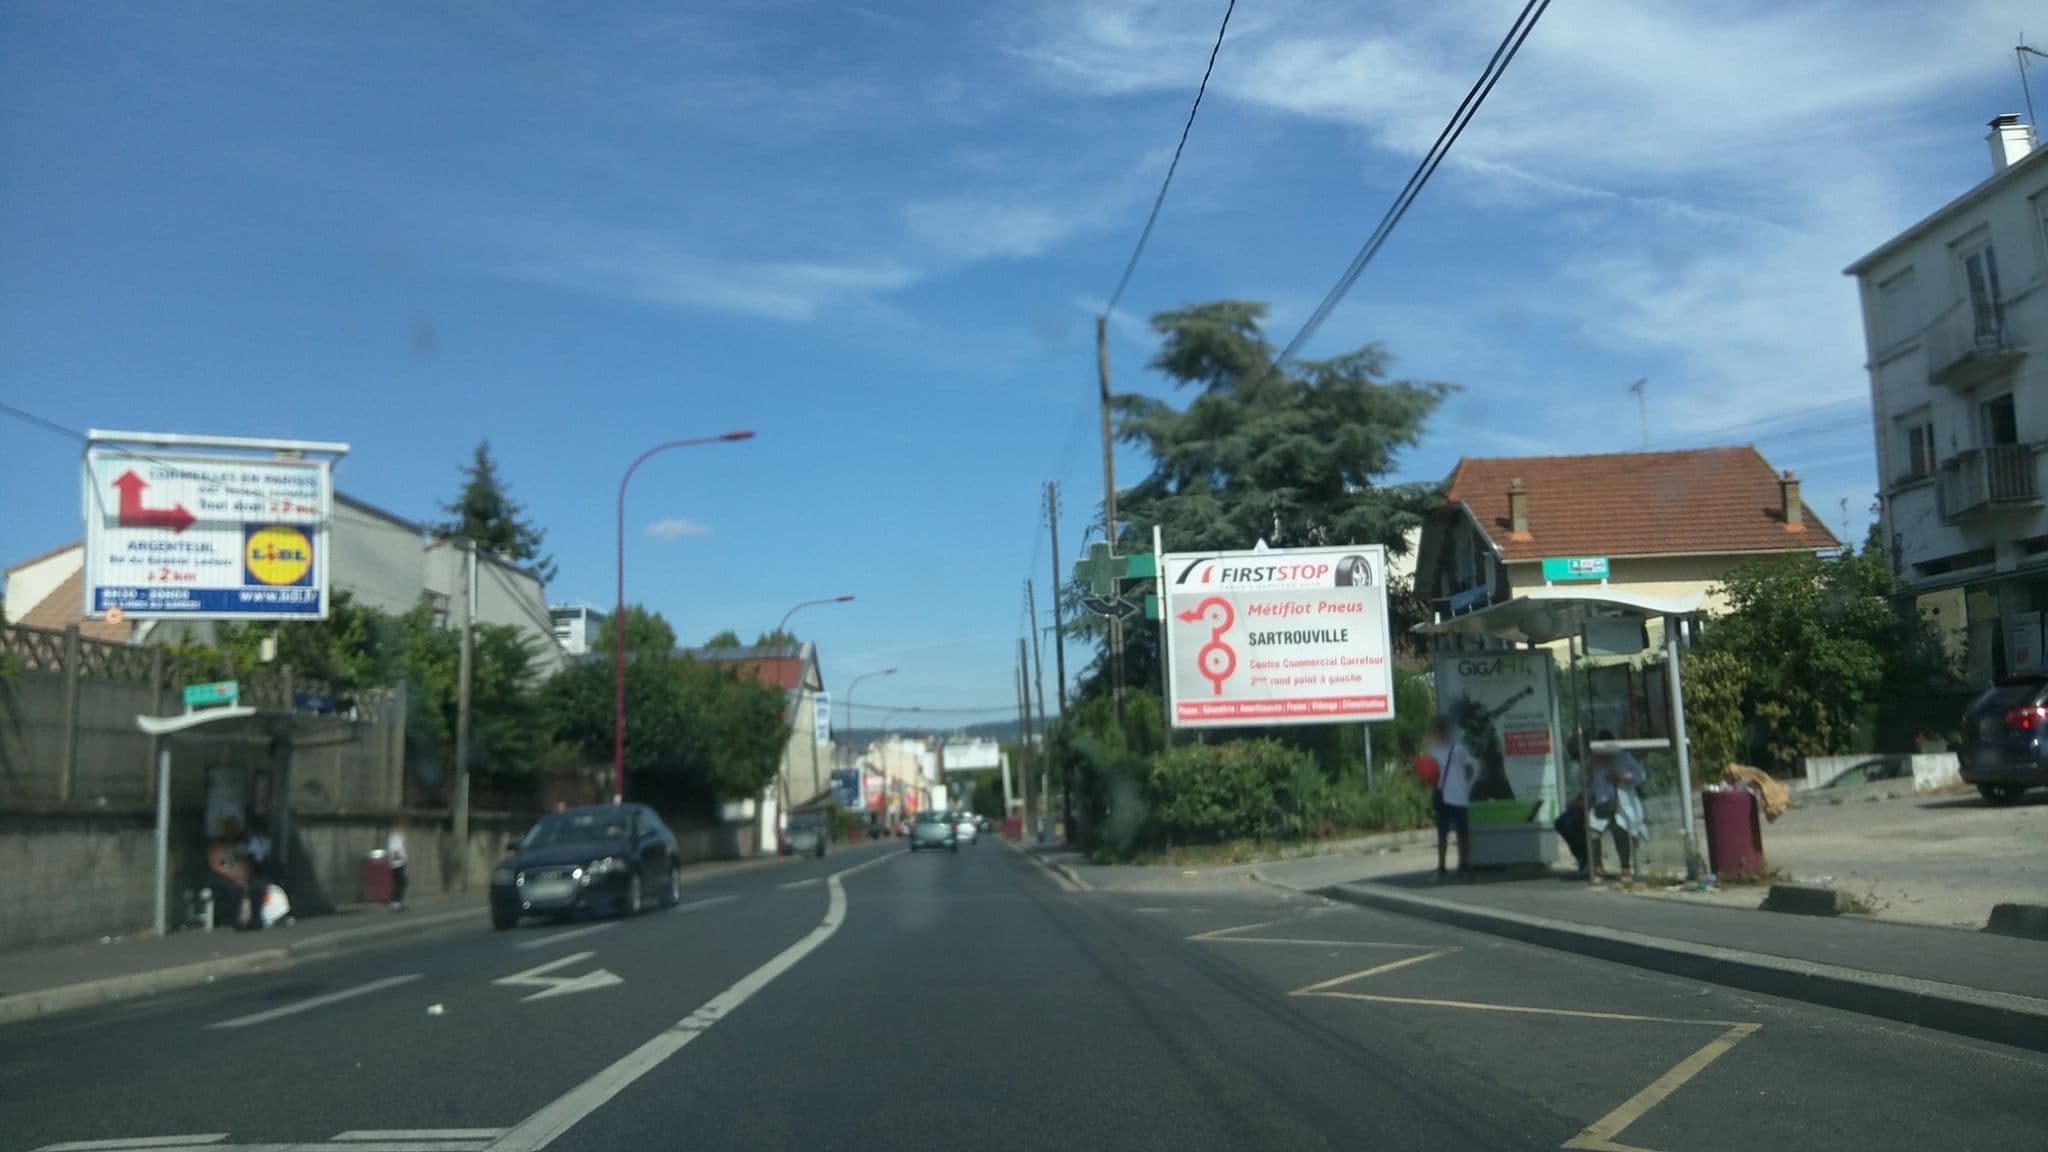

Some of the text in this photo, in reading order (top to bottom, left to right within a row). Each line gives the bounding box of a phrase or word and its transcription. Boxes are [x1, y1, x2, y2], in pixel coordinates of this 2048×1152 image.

[160, 567, 170, 581] 2
[1221, 564, 1329, 583] FIRSTSTOP
[1248, 601, 1363, 618] Métifiot Pneus
[1248, 628, 1349, 646] SARTROUVILLE
[1249, 655, 1384, 670] Centre Commercial Carrefour
[1270, 675, 1290, 686] rond
[1293, 674, 1316, 687] point
[1328, 673, 1361, 686] gauche
